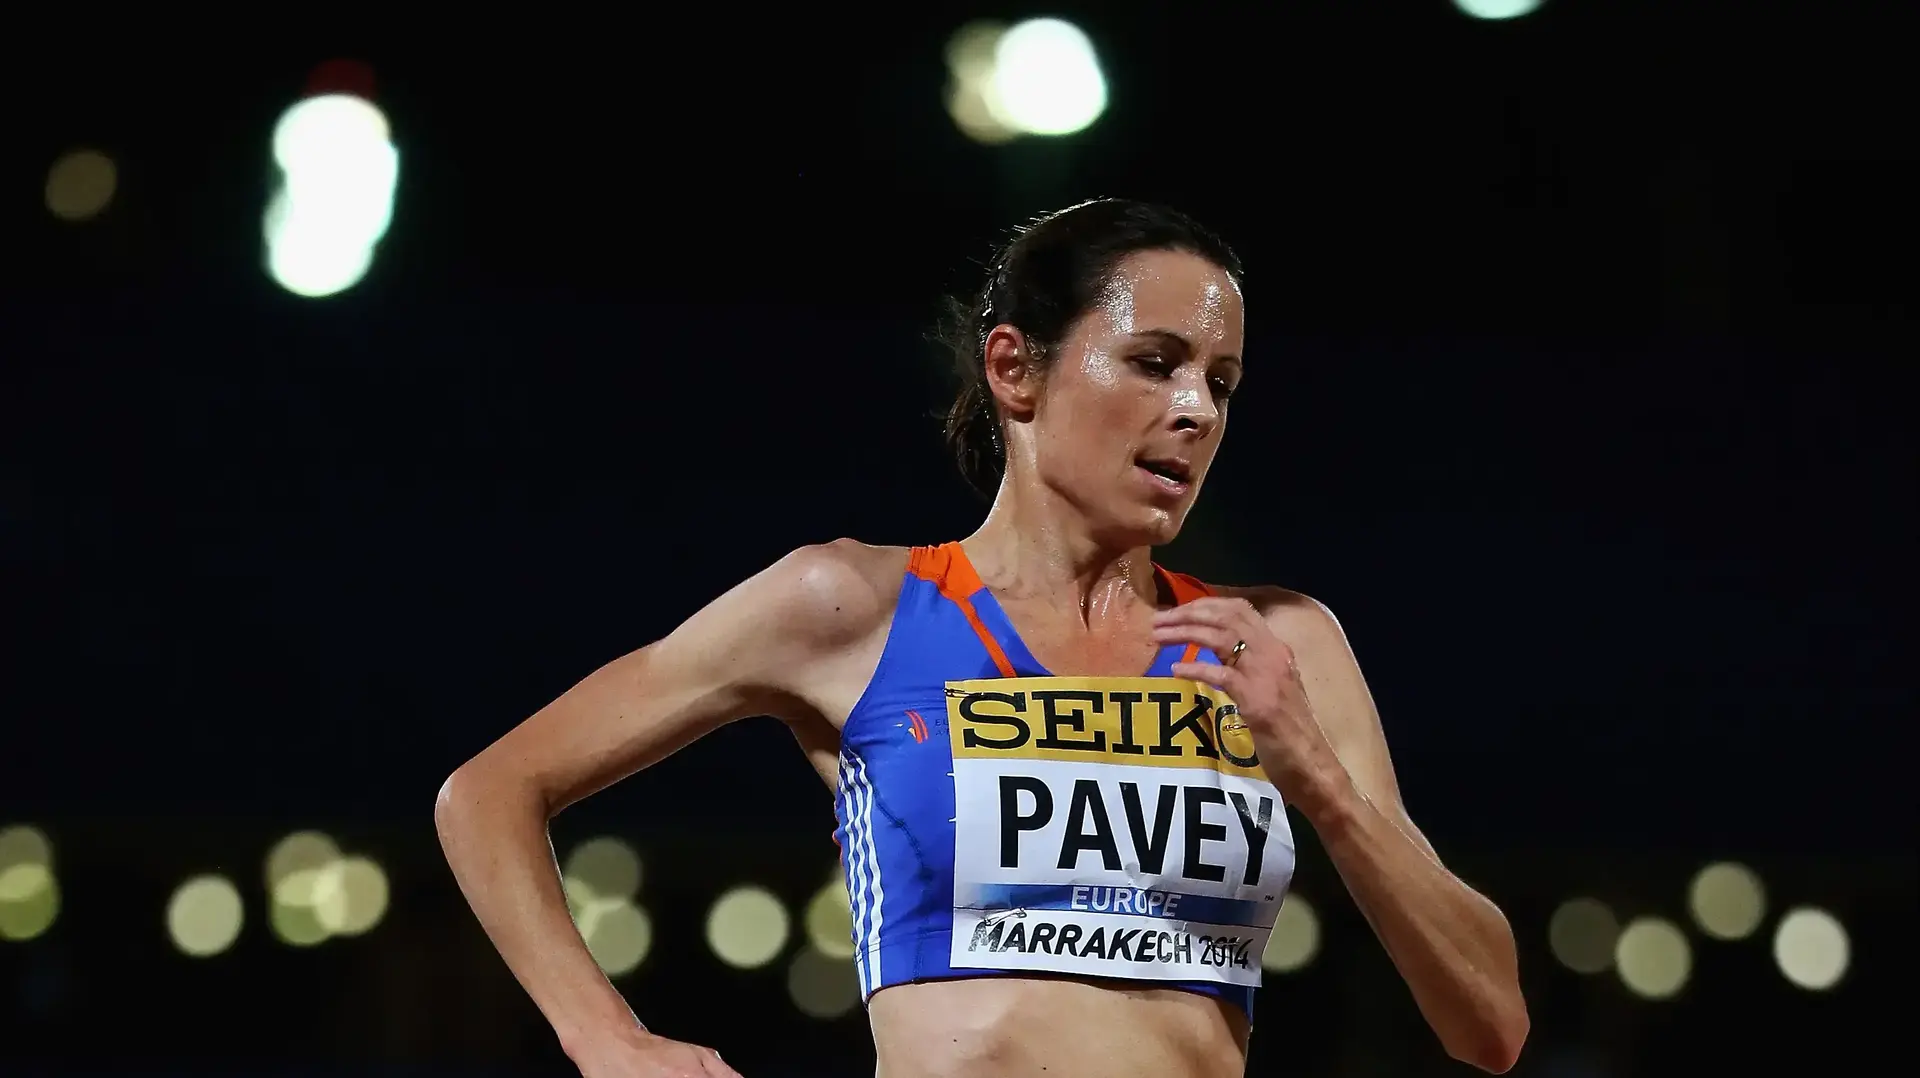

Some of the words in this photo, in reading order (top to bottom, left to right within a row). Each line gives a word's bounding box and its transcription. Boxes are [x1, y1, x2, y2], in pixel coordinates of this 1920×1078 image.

[958, 691, 1261, 768] SEIKO
[998, 775, 1274, 886] PAVEY
[1070, 886, 1182, 918] EUROPE
[967, 920, 1192, 965] MARRAKECH
[1199, 934, 1255, 970] 2014
